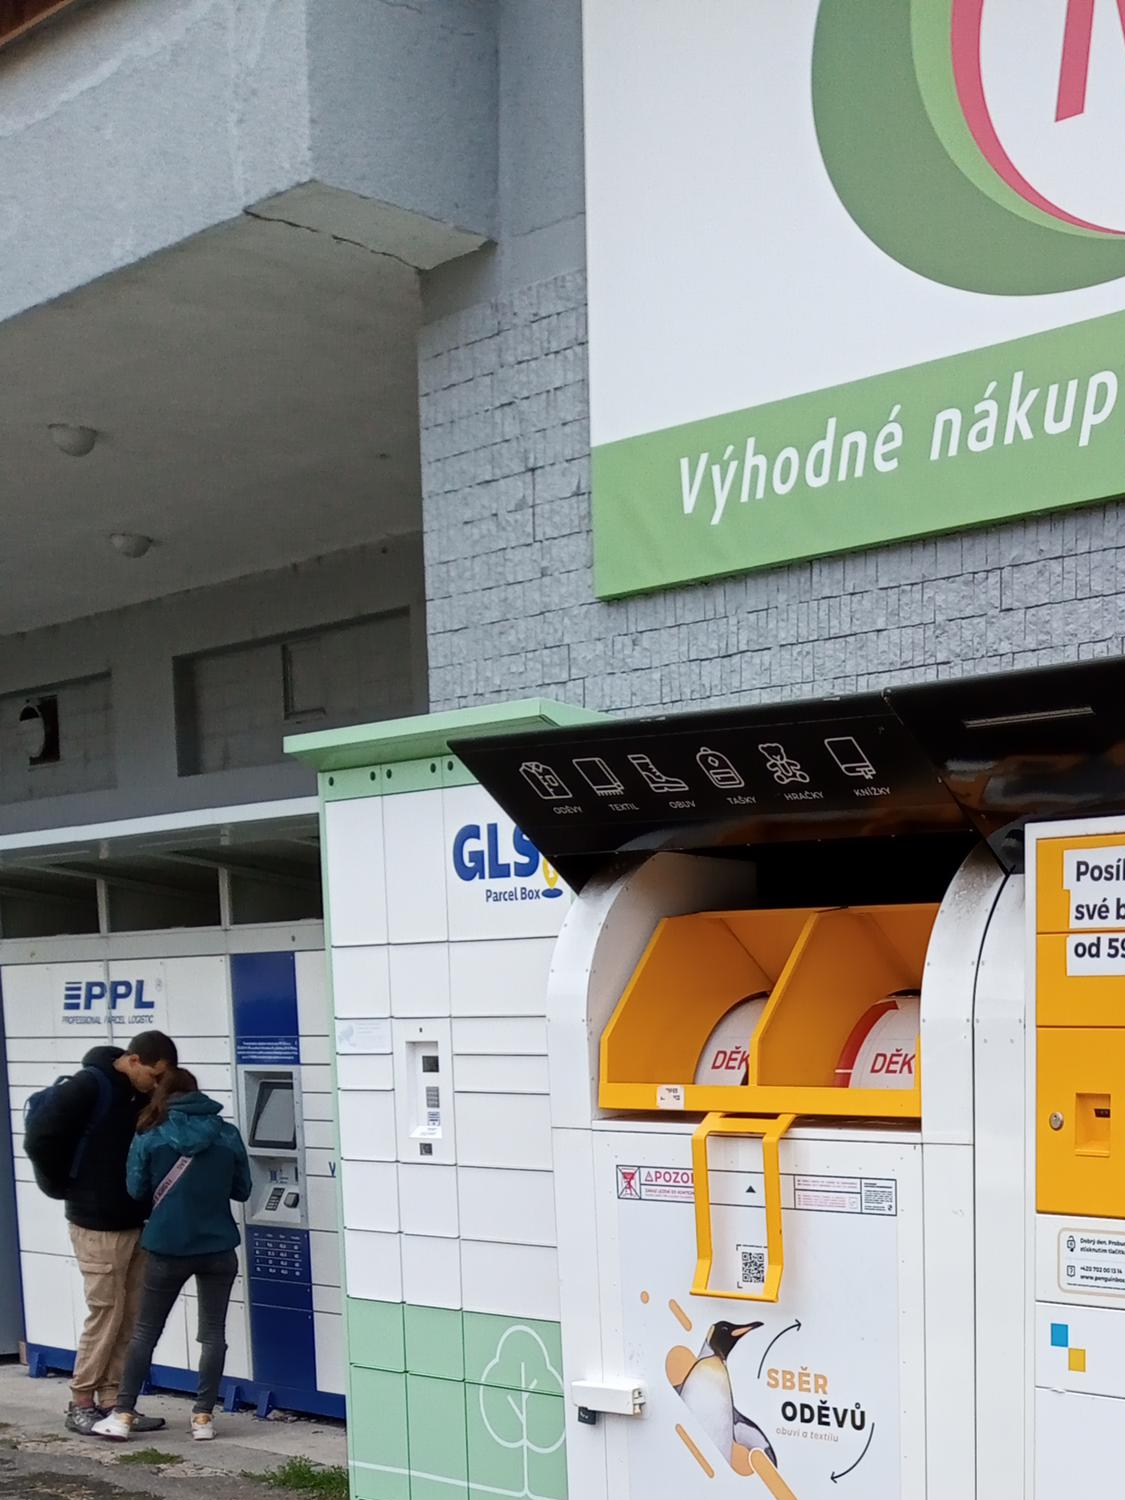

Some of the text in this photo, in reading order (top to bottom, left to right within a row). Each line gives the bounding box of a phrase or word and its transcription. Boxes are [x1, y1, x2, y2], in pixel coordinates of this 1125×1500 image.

[679, 404, 903, 525] Výhodné
[726, 795, 757, 805] TAŠKY
[784, 790, 824, 801] HRAČKY
[853, 786, 892, 797] KNÍŽKY
[608, 803, 640, 812] TEXTIL
[668, 800, 697, 809] OBUV
[452, 822, 541, 882] GLS
[486, 886, 541, 902] Parcel Box
[1074, 898, 1110, 921] své
[1073, 936, 1101, 958] od
[84, 980, 155, 1010] PPL
[767, 1366, 828, 1394] SBĚR
[781, 1400, 866, 1431] ODĚVŮ
[776, 1426, 839, 1442] obuvi a textilu
